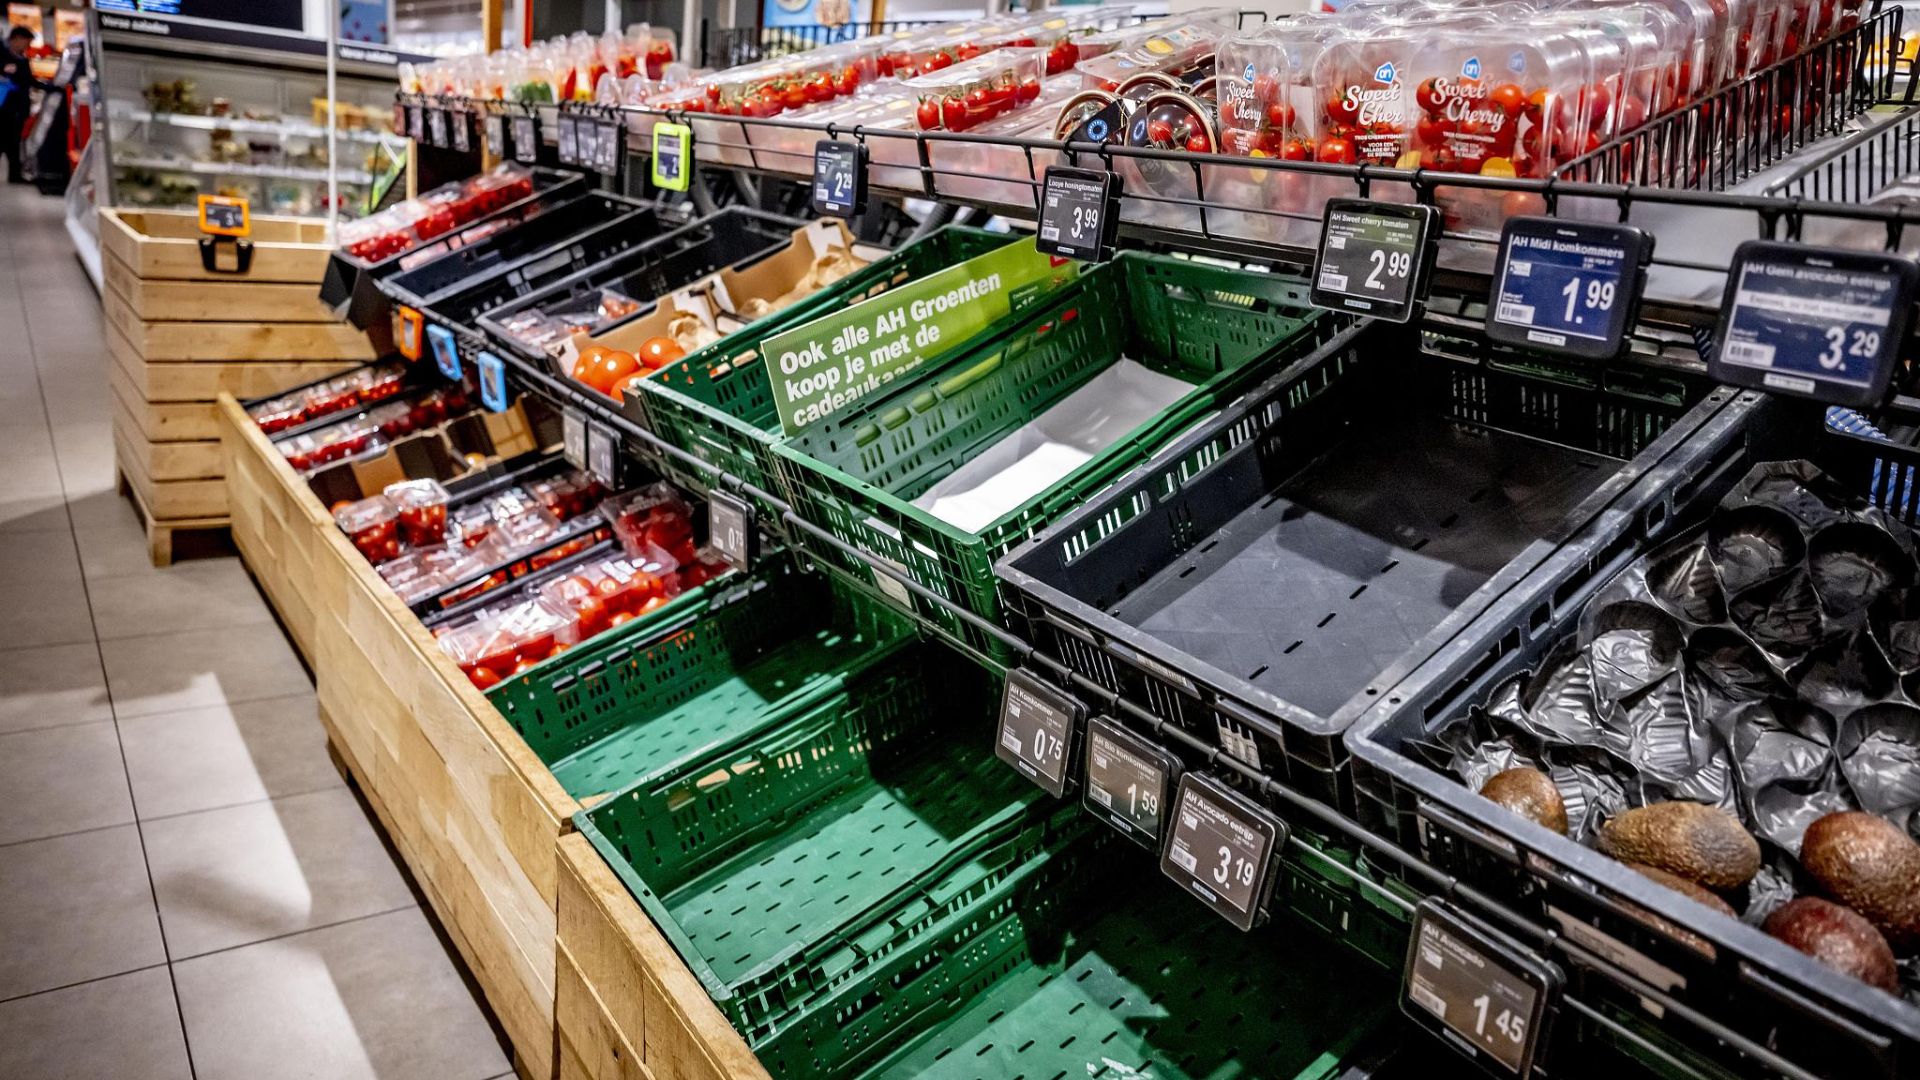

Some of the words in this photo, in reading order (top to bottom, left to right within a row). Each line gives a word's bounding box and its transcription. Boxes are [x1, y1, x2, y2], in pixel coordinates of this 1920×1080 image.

[1226, 81, 1256, 104] Sweet
[1342, 83, 1401, 112] Sweet
[1430, 77, 1487, 105] Sweet
[1233, 98, 1262, 127] Cherry
[1446, 96, 1505, 133] Cherry
[1331, 213, 1341, 221] AH
[1342, 214, 1361, 224] Sweet
[1361, 216, 1381, 228] cherry
[1382, 219, 1410, 230] tomaten
[1512, 235, 1529, 247] AH
[1530, 238, 1552, 249] Midi
[1552, 240, 1625, 259] komkommers
[1748, 262, 1764, 274] AH
[1795, 269, 1849, 284] avocado
[779, 340, 828, 376] Ook
[831, 325, 870, 357] alle
[876, 305, 907, 331] AH
[910, 272, 1001, 321] Groenten
[784, 365, 842, 402] koop
[844, 354, 866, 383] je
[869, 338, 911, 369] met
[915, 323, 941, 348] de
[1010, 684, 1020, 695] AH
[1020, 689, 1053, 717] Komkommer
[1094, 734, 1104, 745] AH
[1115, 748, 1156, 777] komkommer
[1185, 791, 1198, 804] AH
[1198, 798, 1230, 825] Avocado
[1229, 820, 1254, 842] eetrijp
[1423, 923, 1440, 939] AH
[1440, 934, 1486, 969] Avocado
